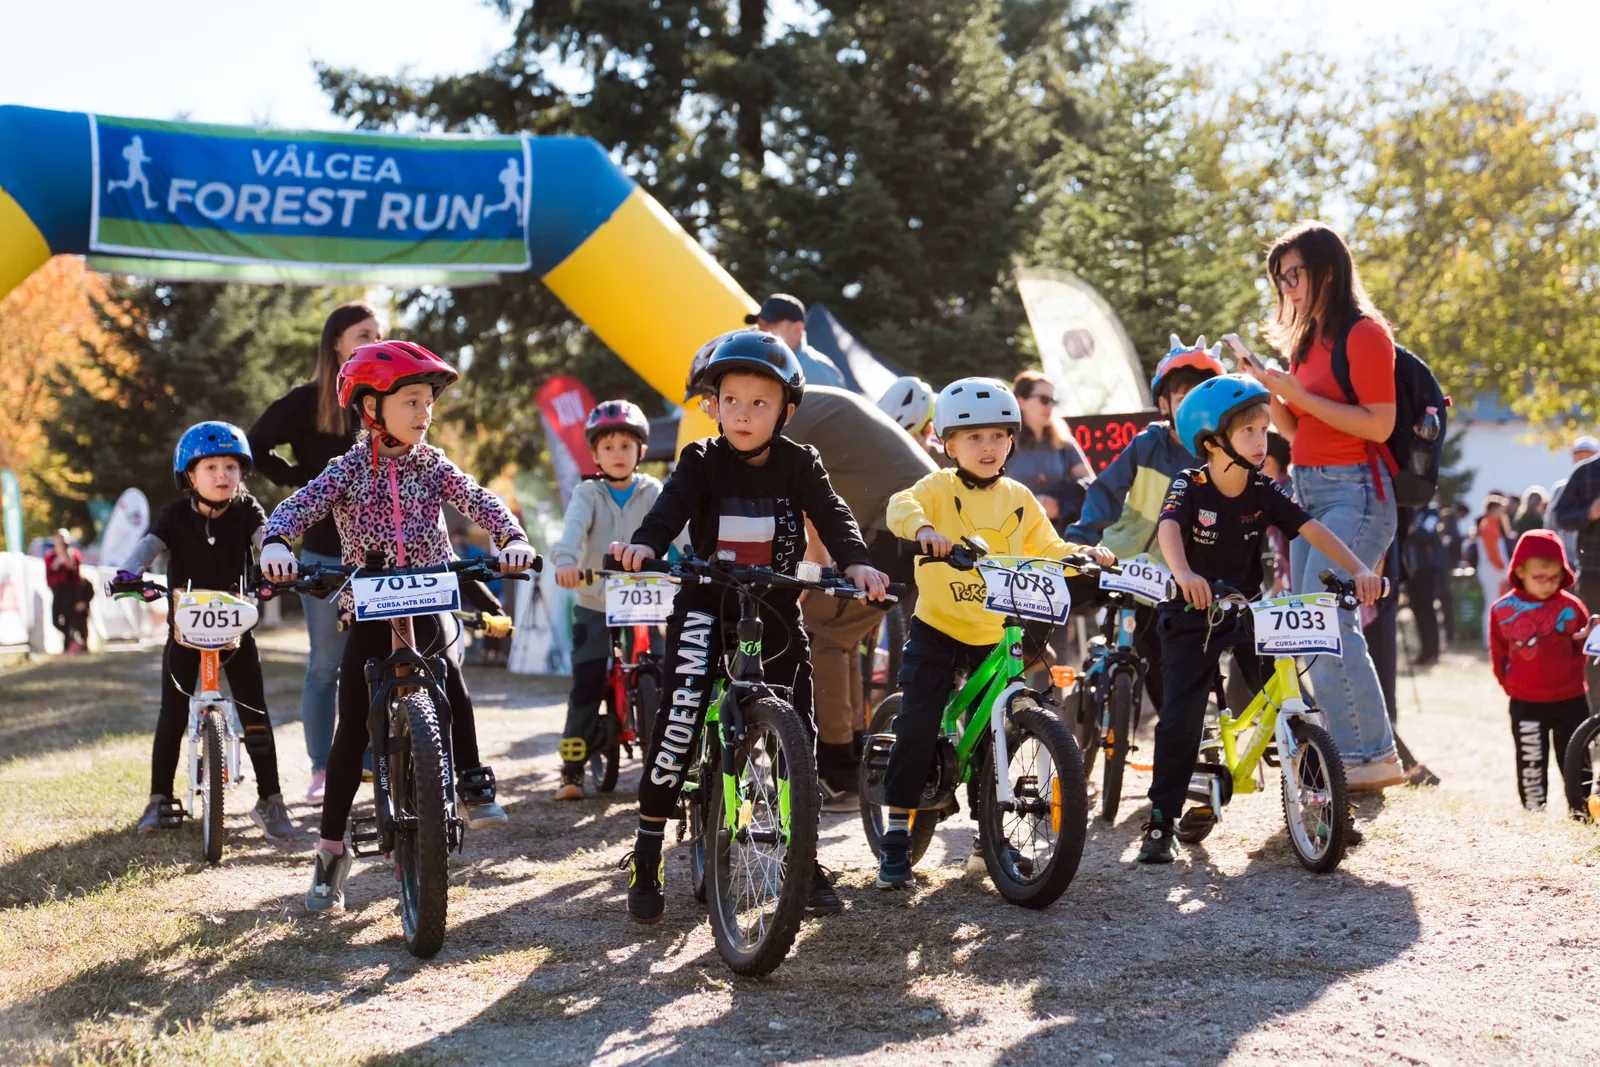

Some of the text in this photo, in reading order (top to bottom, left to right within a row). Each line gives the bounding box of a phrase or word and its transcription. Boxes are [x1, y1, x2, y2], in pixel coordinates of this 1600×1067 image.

[251, 144, 402, 184] VÂLCEA
[167, 178, 484, 231] FOREST RUN
[1070, 421, 1146, 451] 0:30
[370, 575, 438, 592] 7015
[998, 572, 1055, 595] 7078
[376, 601, 401, 609] CURSA
[420, 597, 437, 605] KIDS
[619, 589, 663, 605] 7031
[1036, 604, 1051, 612] KIDS
[189, 610, 242, 628] 7051
[1270, 610, 1326, 630] 7033
[379, 755, 389, 791] AIRFORK
